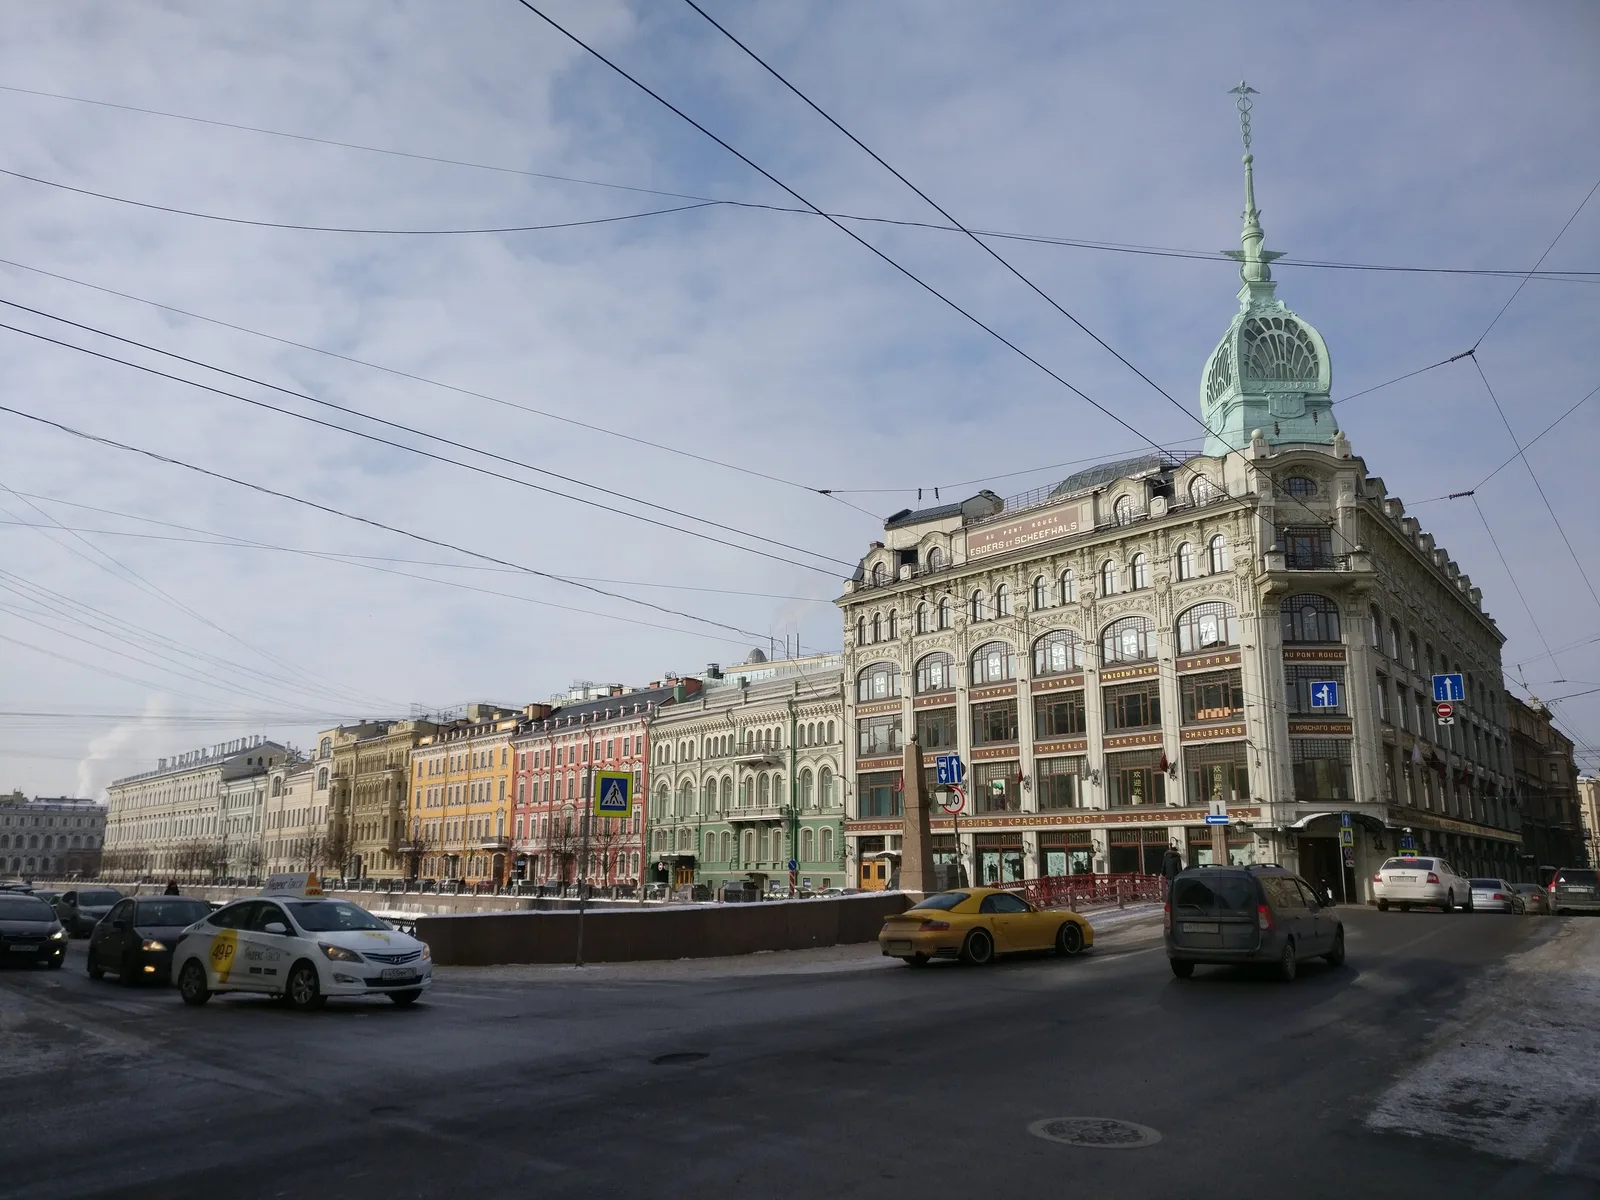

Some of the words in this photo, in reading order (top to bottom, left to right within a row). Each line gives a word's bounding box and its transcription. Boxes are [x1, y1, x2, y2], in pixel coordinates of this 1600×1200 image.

[1003, 526, 1023, 536] PONT
[1032, 516, 1059, 528] ROUGE
[970, 541, 1004, 556] ESDERS
[1014, 522, 1078, 545] SCHEEFHALS
[1187, 656, 1230, 667] ШЛЯПЫ
[1185, 728, 1242, 738] CHAUSSURES
[976, 749, 1014, 757] LINGERIE
[1038, 743, 1083, 752] CHAPEAUX
[943, 819, 993, 828] МАГАЗИНЪ
[1009, 816, 1062, 826] КРАСНАГО
[1067, 814, 1106, 824] МОСТА
